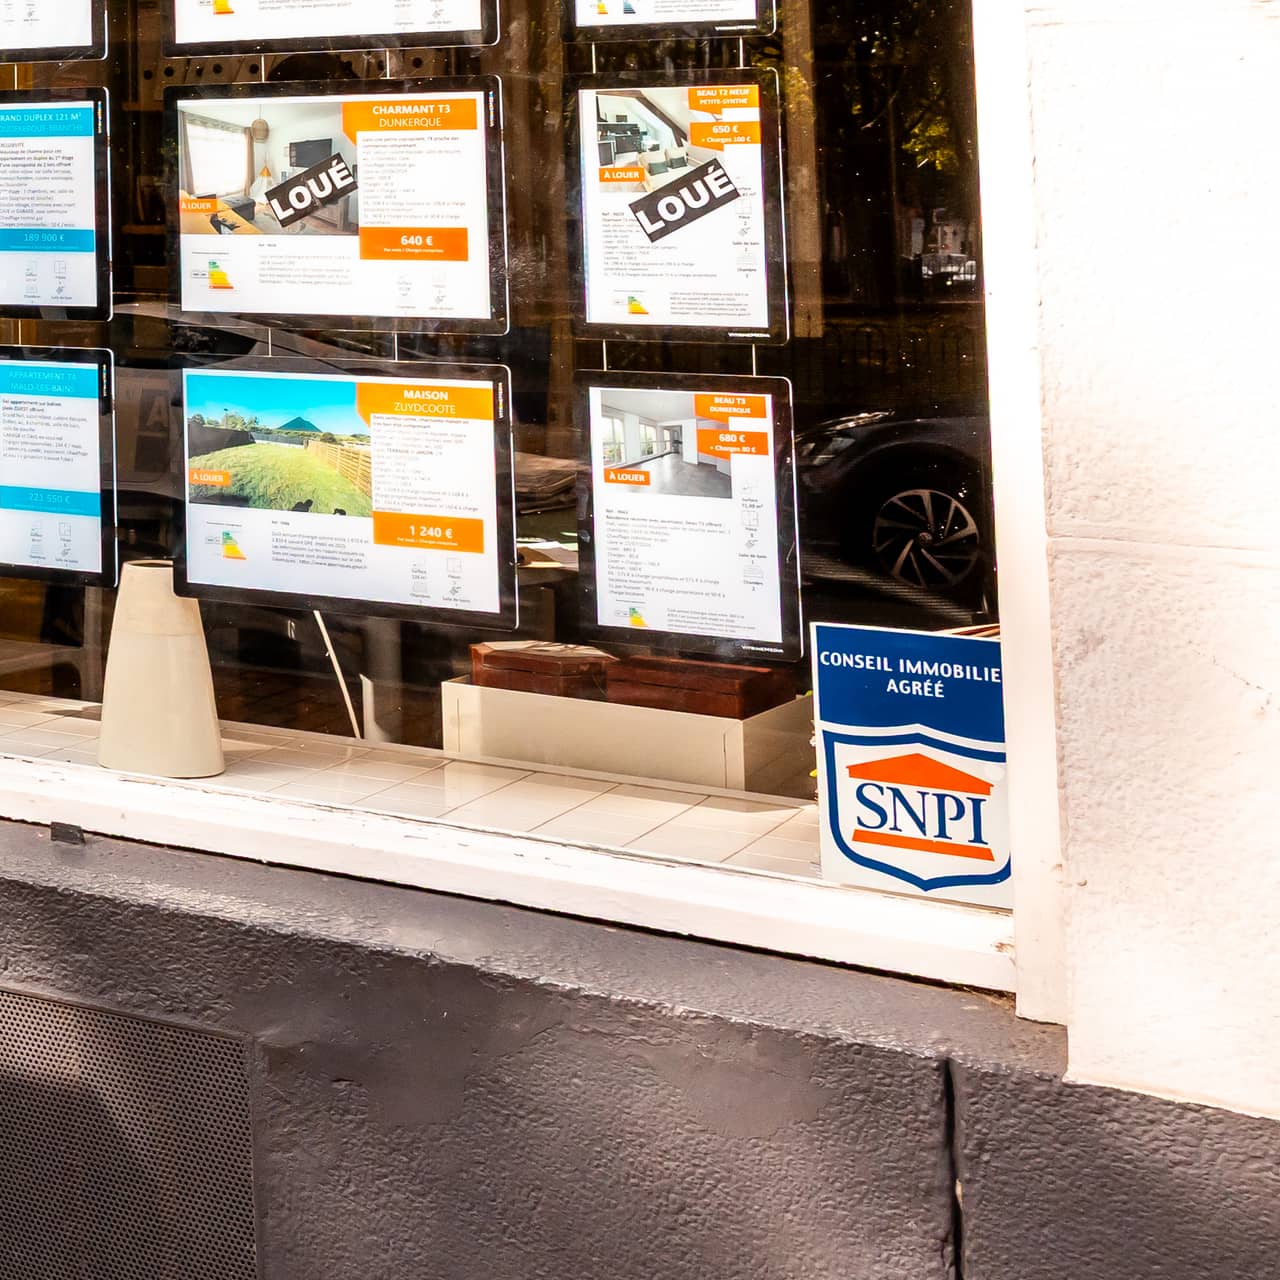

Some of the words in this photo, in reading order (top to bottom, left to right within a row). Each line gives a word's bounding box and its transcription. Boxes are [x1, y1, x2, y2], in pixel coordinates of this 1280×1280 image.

[372, 105, 433, 116] CHARMANT
[437, 104, 451, 114] T3
[24, 113, 54, 122] DUPLEX
[55, 112, 68, 121] 121
[379, 117, 442, 128] DUNKERQUE
[712, 125, 730, 134] 650
[612, 170, 639, 179] LOUER
[270, 160, 354, 221] LOUÉ
[635, 163, 736, 236] LOUÉ
[189, 201, 211, 210] LOUER
[24, 233, 40, 242] 189
[401, 236, 422, 246] 640
[425, 236, 433, 246] €
[404, 390, 449, 401] MAISON
[394, 402, 456, 414] ZUYDCOOTE
[719, 433, 737, 442] 680
[201, 473, 224, 483] LOUER
[618, 472, 645, 482] LOUER
[420, 526, 442, 538] 240
[445, 528, 453, 539] €
[820, 651, 893, 672] CONSEIL
[899, 658, 1001, 683] IMMOBILIE
[886, 678, 944, 698] AGRÉÉ
[856, 782, 989, 846] SNPI
